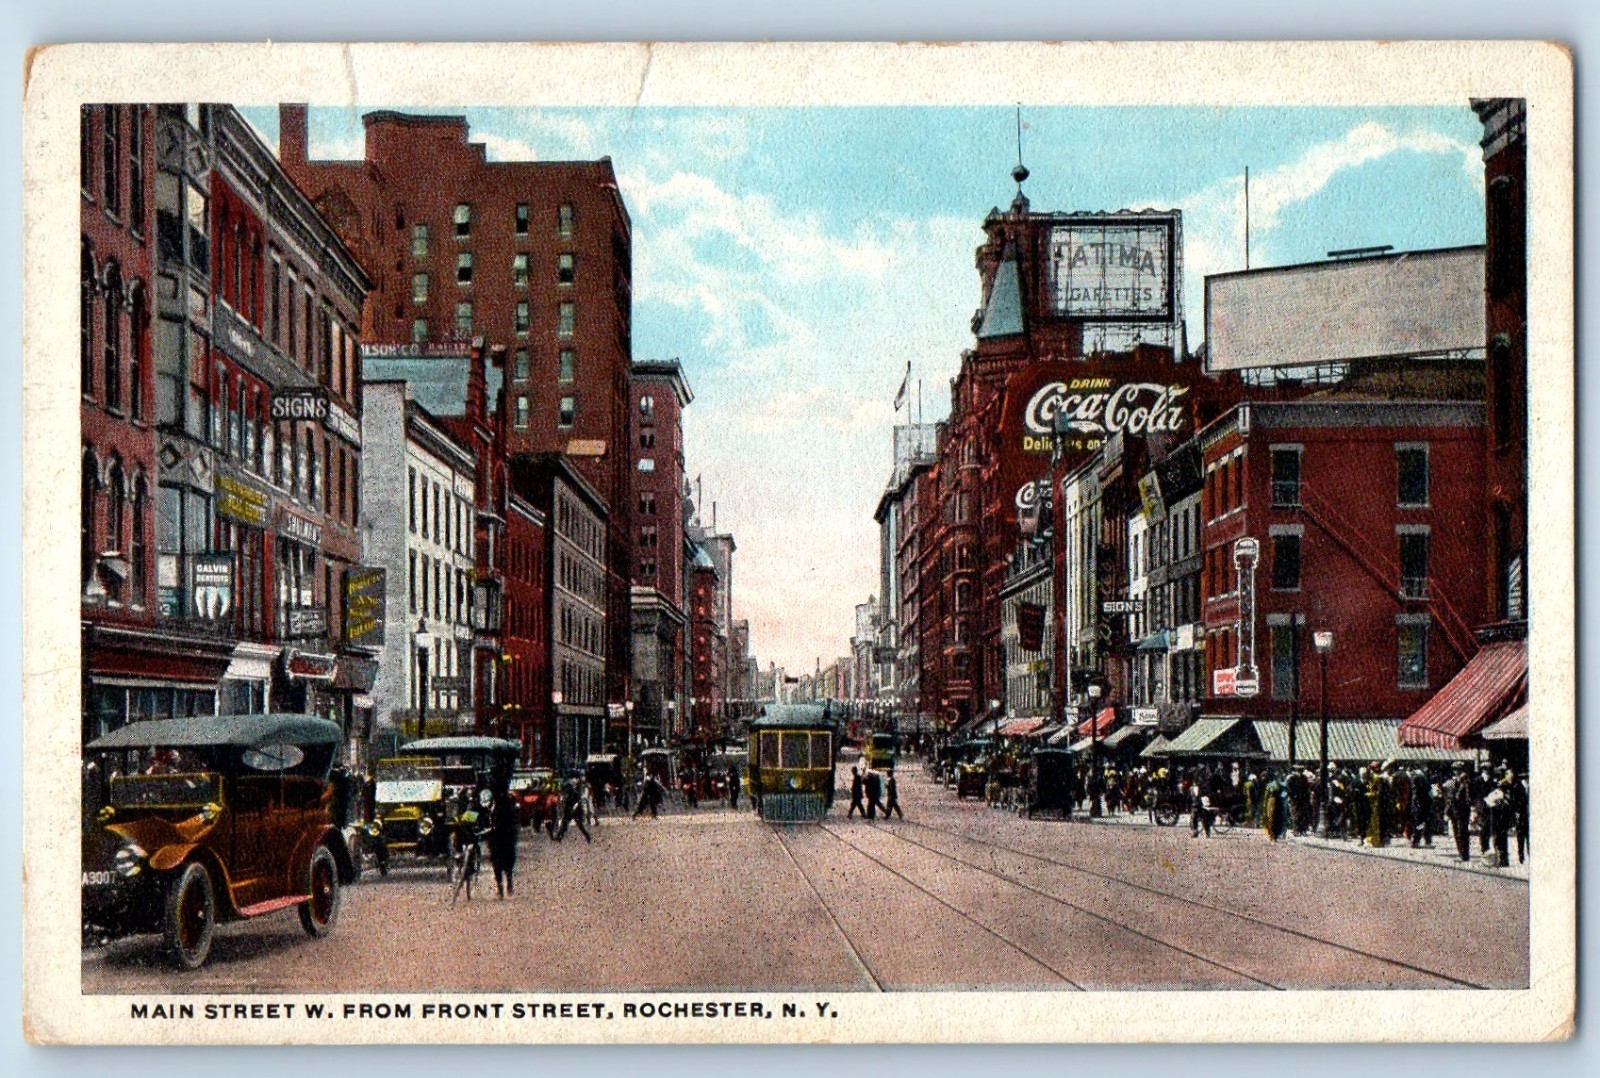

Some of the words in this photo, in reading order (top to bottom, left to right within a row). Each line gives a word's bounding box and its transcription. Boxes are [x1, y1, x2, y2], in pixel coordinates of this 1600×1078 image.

[1069, 378, 1111, 389] DRINK
[272, 397, 327, 418] SIGNS
[1103, 601, 1143, 612] SIGNS
[130, 1004, 194, 1019] MAIN
[204, 1004, 295, 1019] STREET
[305, 1004, 334, 1019] W.
[343, 1004, 412, 1019] FROM
[422, 1003, 504, 1019] FRONT
[512, 1003, 614, 1020] STREET,
[623, 1002, 773, 1019] ROCHESTER,
[782, 1003, 806, 1018] N.
[816, 1002, 839, 1018] Y.
